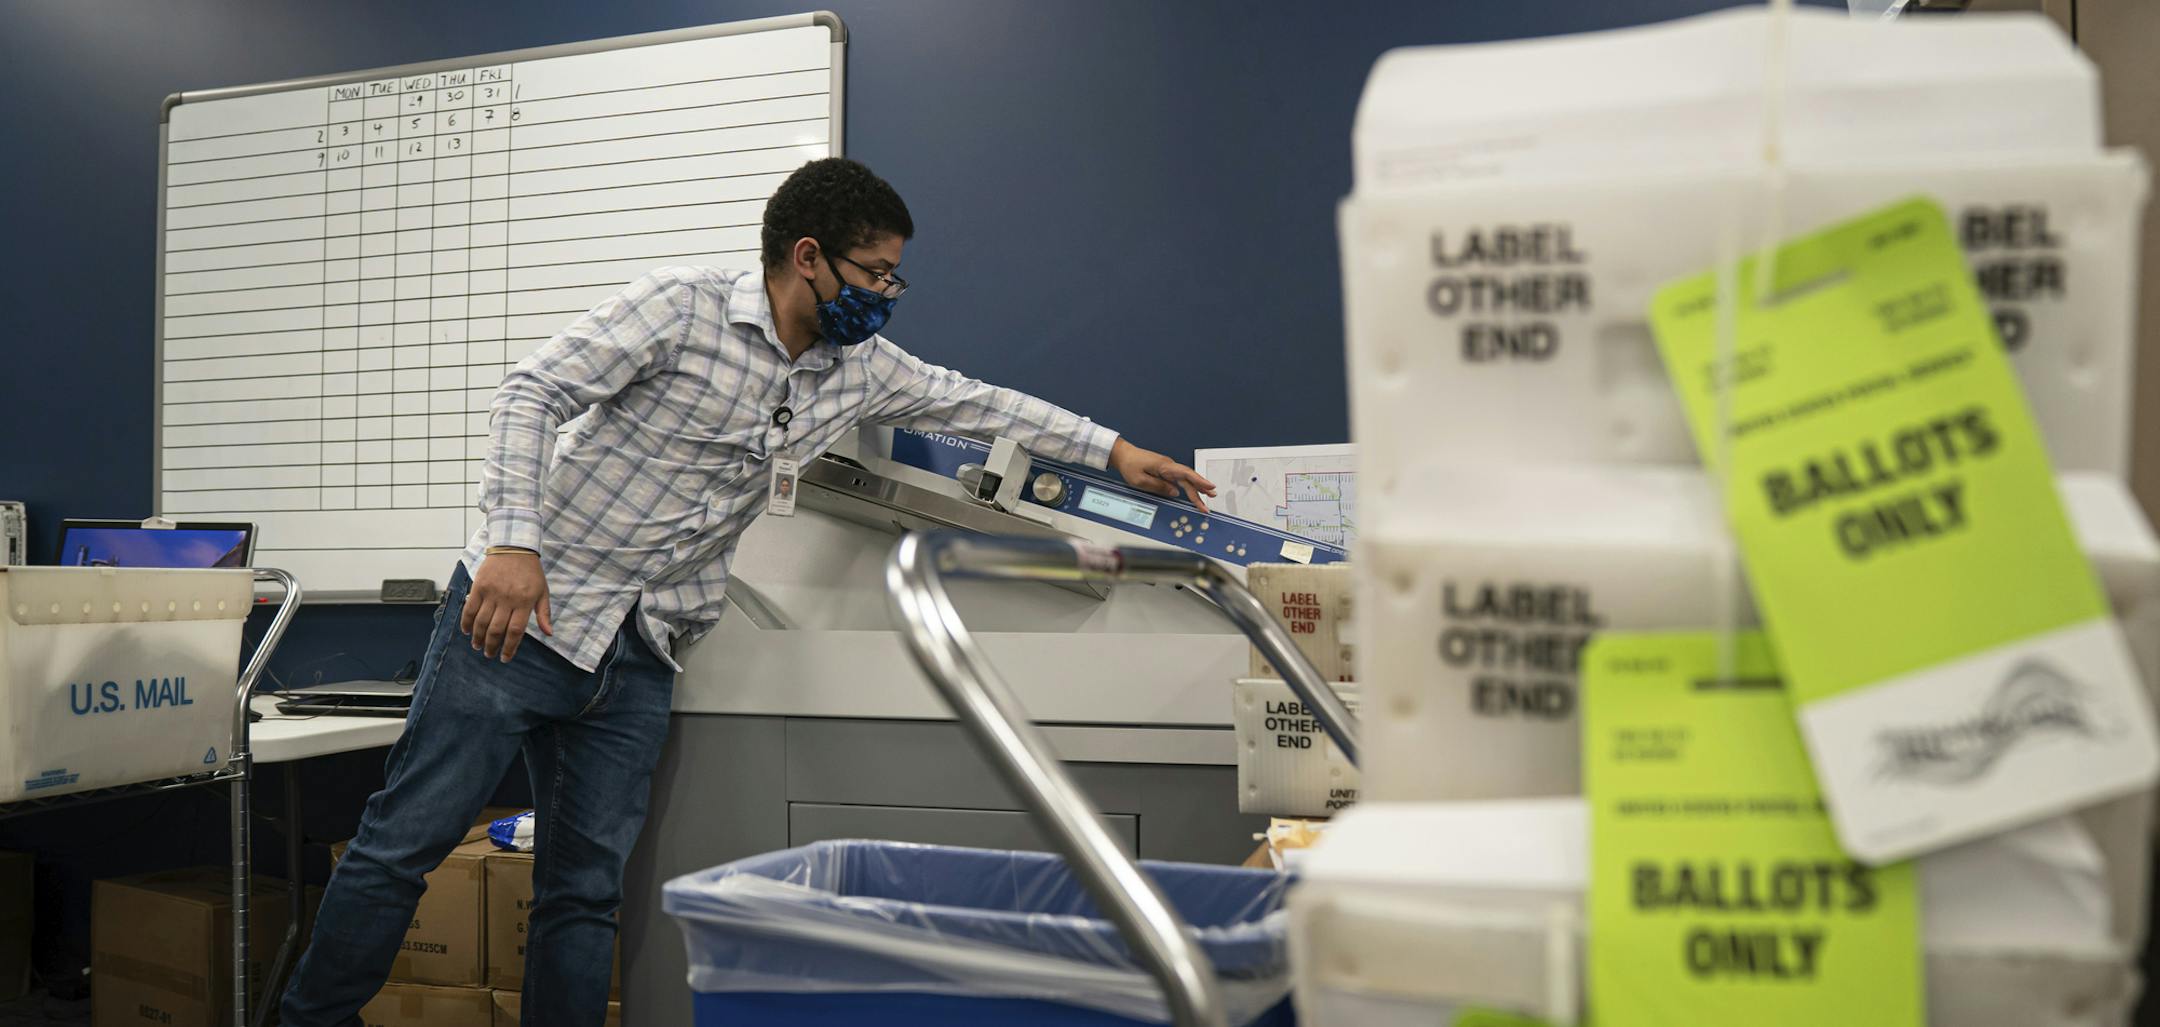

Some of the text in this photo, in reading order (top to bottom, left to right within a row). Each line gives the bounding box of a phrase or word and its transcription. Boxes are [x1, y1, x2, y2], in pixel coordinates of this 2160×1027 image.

[335, 69, 502, 100] MON TUE WED THU FRI
[408, 95, 423, 107] 29
[447, 91, 464, 102] 30
[484, 87, 500, 98] 31
[317, 108, 521, 143] 2 3 4 5 6 7 8
[317, 138, 461, 167] 9 10 11 12 13
[1430, 224, 1587, 269] LABEL
[1960, 205, 2063, 251] BEL
[1427, 272, 1592, 317] OTHER
[1976, 257, 2068, 302] HER
[1461, 322, 1560, 363] END
[1762, 407, 2001, 517] BALLOTS
[1835, 479, 1969, 562] ONLY
[1281, 592, 1320, 606] LABEL
[1283, 607, 1321, 620] OTHER
[1442, 580, 1606, 629] LABEL
[1291, 621, 1315, 634] END
[70, 677, 193, 716] U.S. MAIL
[1266, 700, 1312, 716] LABE
[1470, 676, 1577, 721] END
[1277, 735, 1312, 749] END
[1330, 788, 1357, 799] UNIT
[1630, 860, 1880, 913] BALLOTS
[1685, 928, 1826, 982] ONLY
